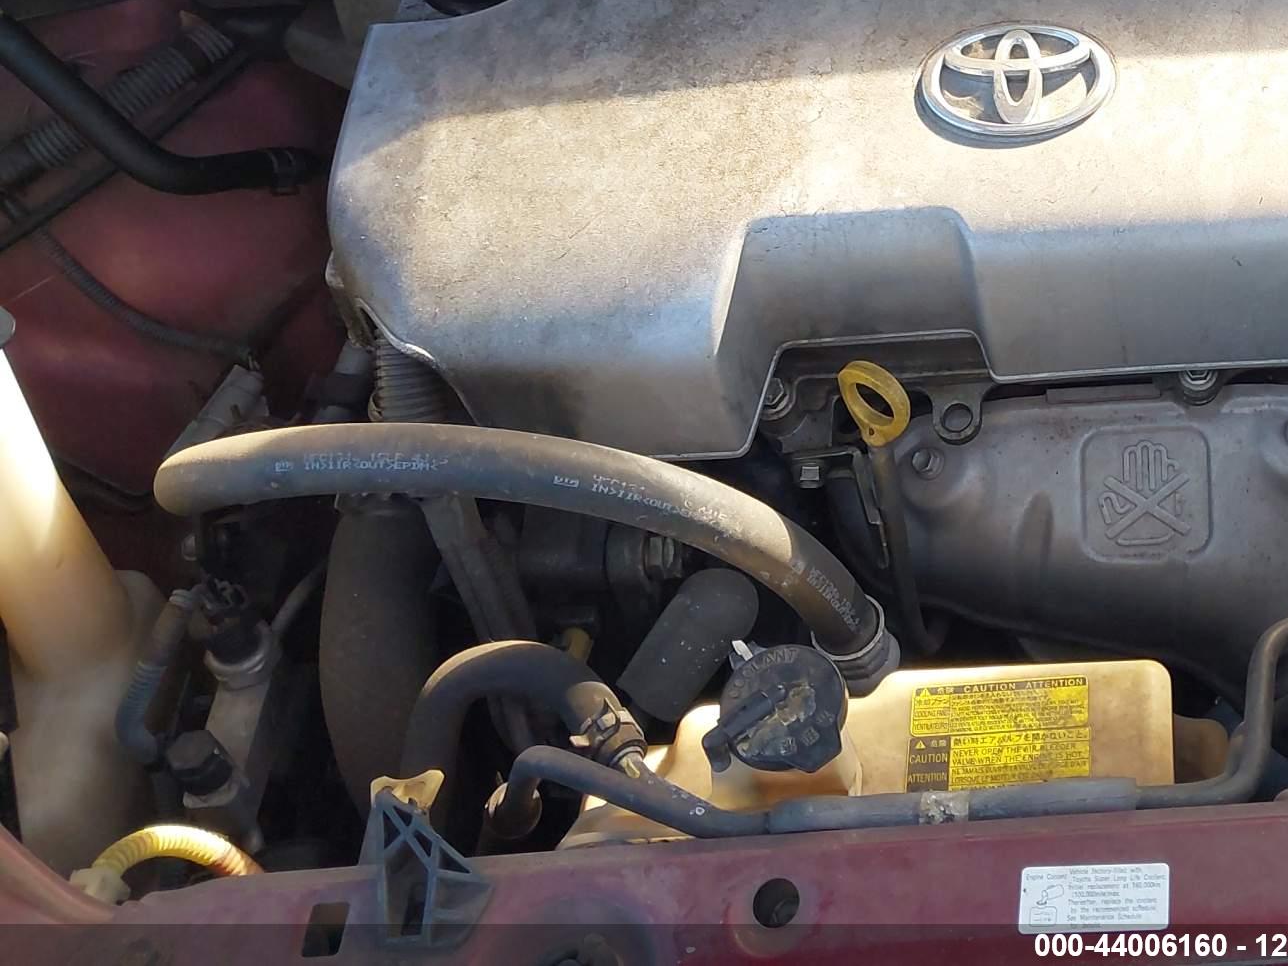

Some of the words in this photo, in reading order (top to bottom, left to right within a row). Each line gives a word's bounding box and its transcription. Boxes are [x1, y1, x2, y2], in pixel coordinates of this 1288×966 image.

[964, 683, 1016, 693] CAUTION
[1025, 679, 1083, 689] ATTENTION
[1007, 746, 1022, 754] THE
[910, 753, 948, 764] CAUTION
[908, 772, 947, 783] ATTENTION
